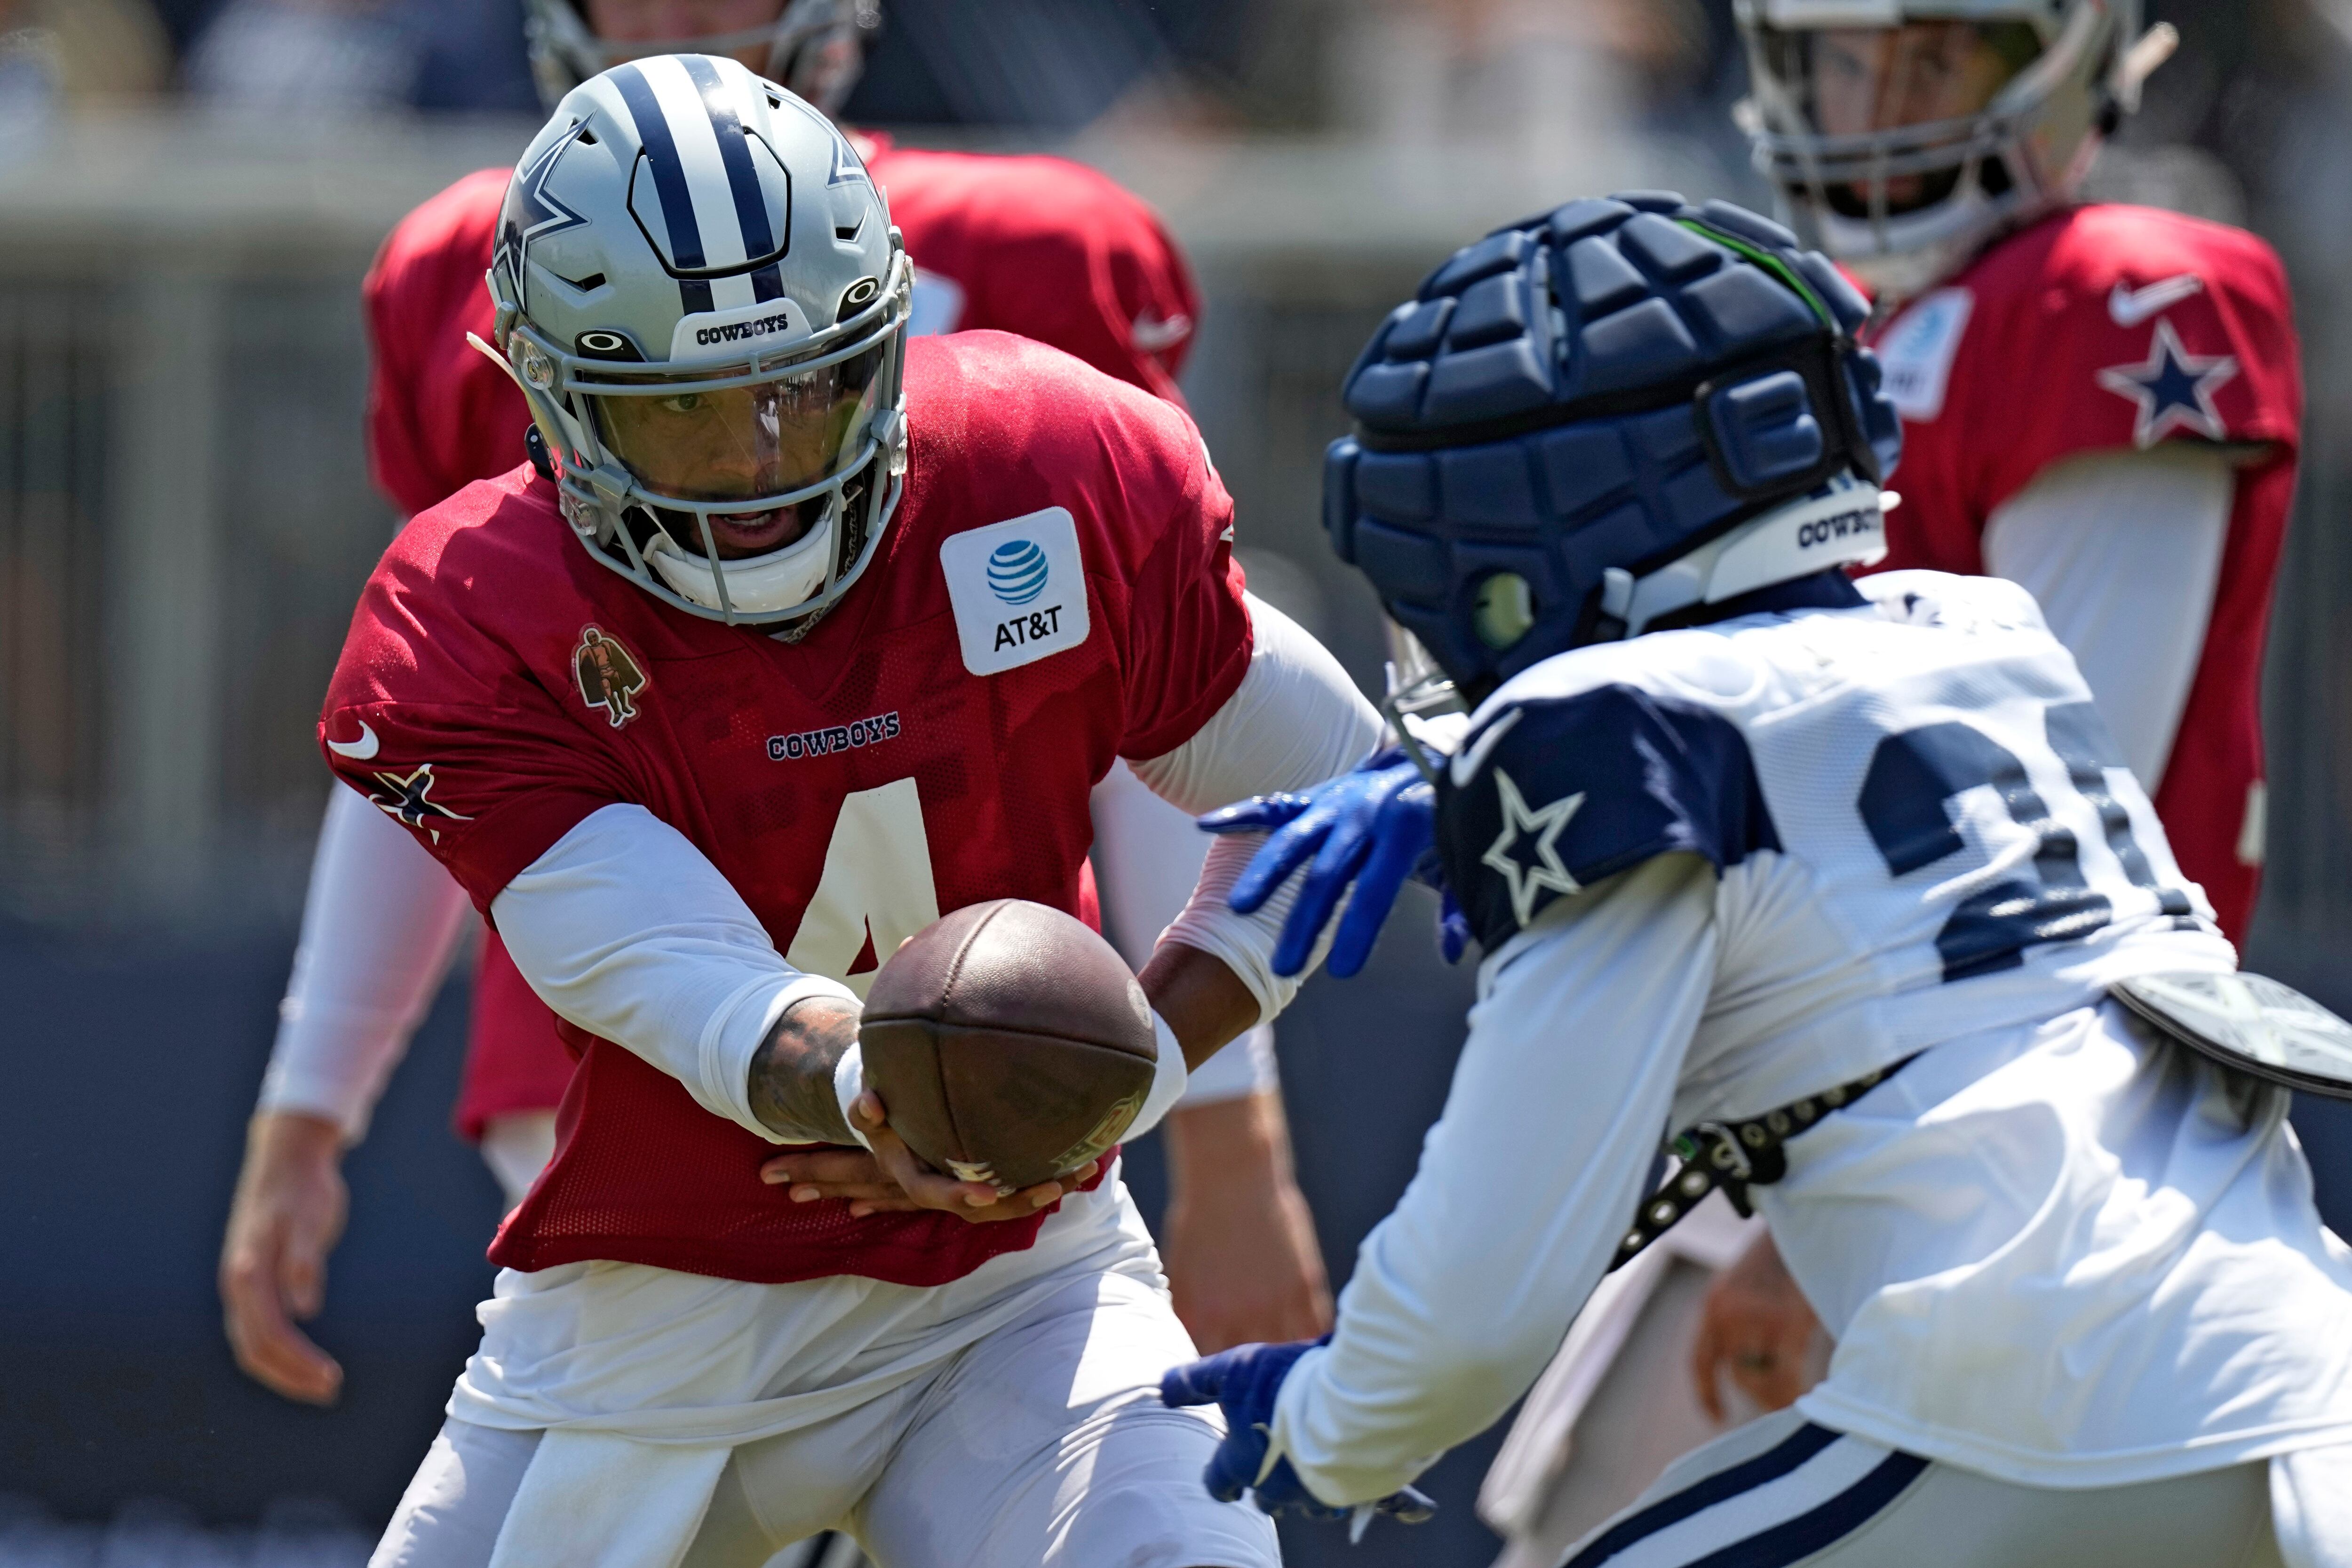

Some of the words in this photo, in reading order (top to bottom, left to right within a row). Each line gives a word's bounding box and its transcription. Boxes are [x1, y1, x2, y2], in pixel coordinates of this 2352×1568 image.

[696, 313, 788, 345] COWBOYS
[994, 605, 1062, 652] AT&T
[767, 711, 901, 761] COWBOYS
[786, 776, 941, 1005] 4
